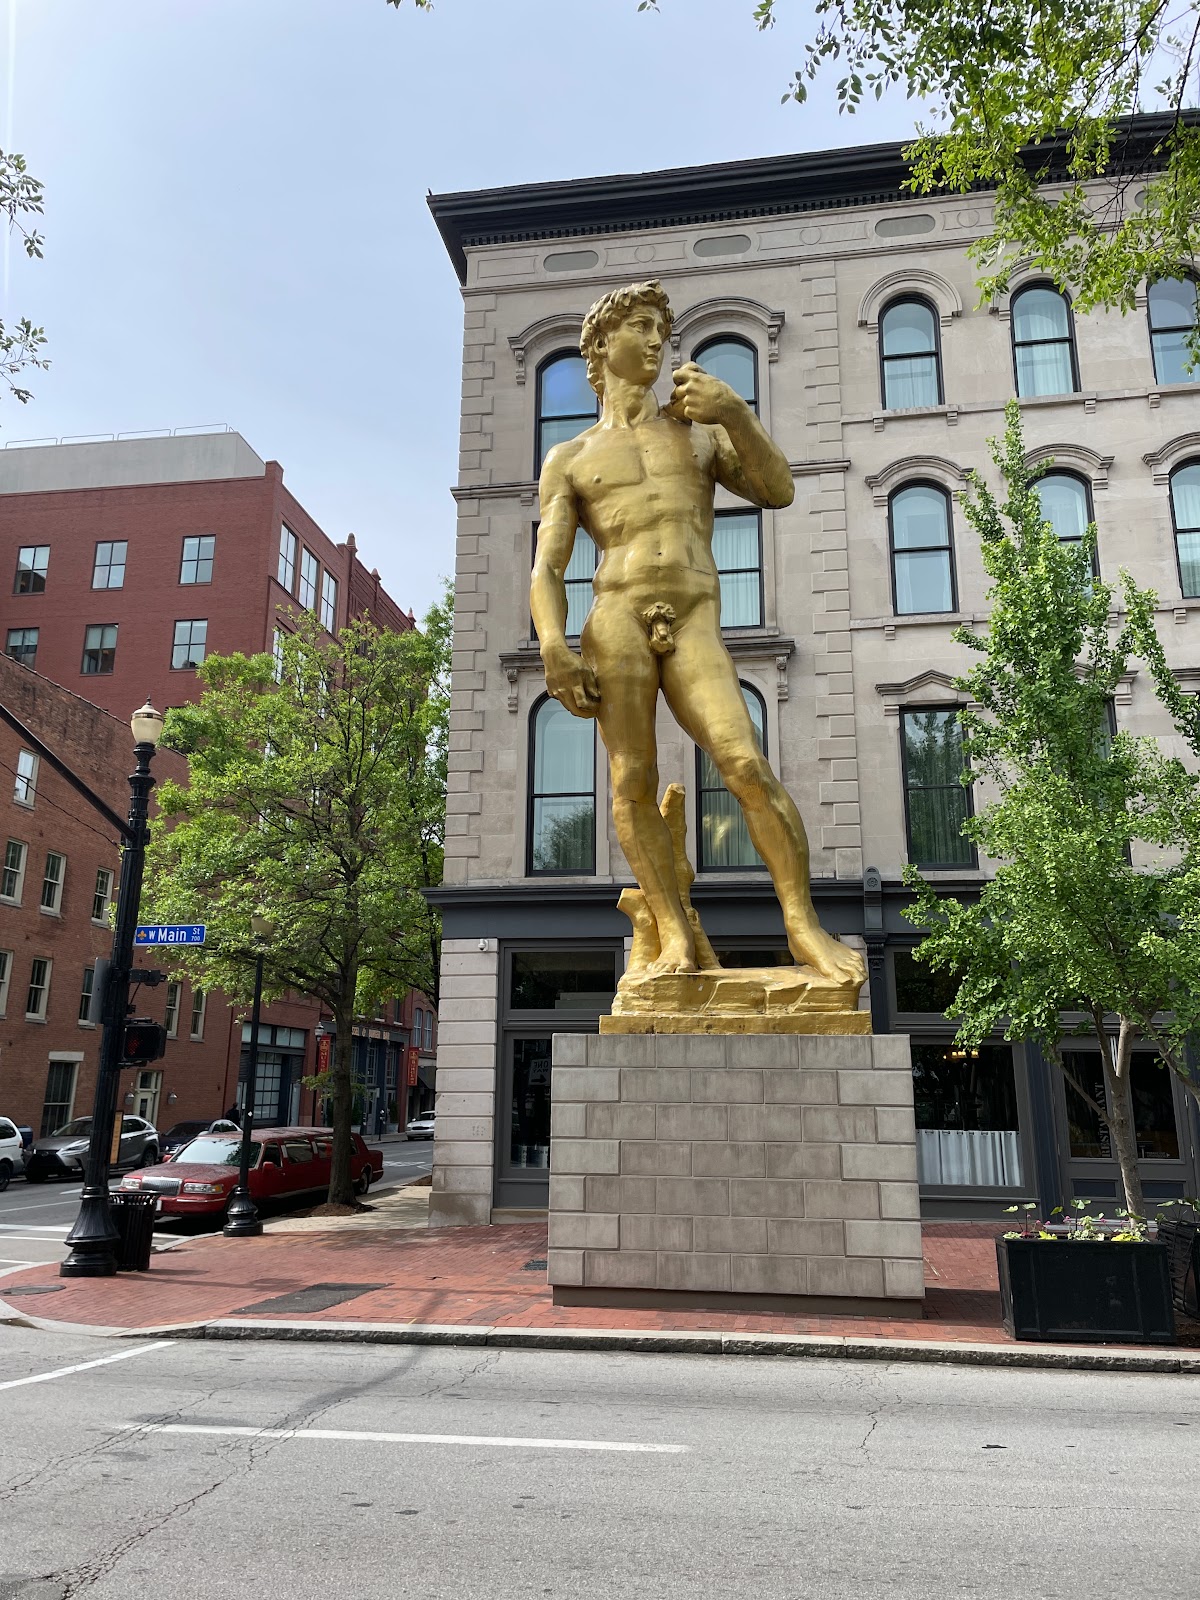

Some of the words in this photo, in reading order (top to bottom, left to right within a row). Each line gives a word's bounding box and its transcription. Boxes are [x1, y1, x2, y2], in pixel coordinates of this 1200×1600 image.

[149, 930, 156, 940] W
[157, 928, 187, 942] Main
[192, 927, 200, 935] St
